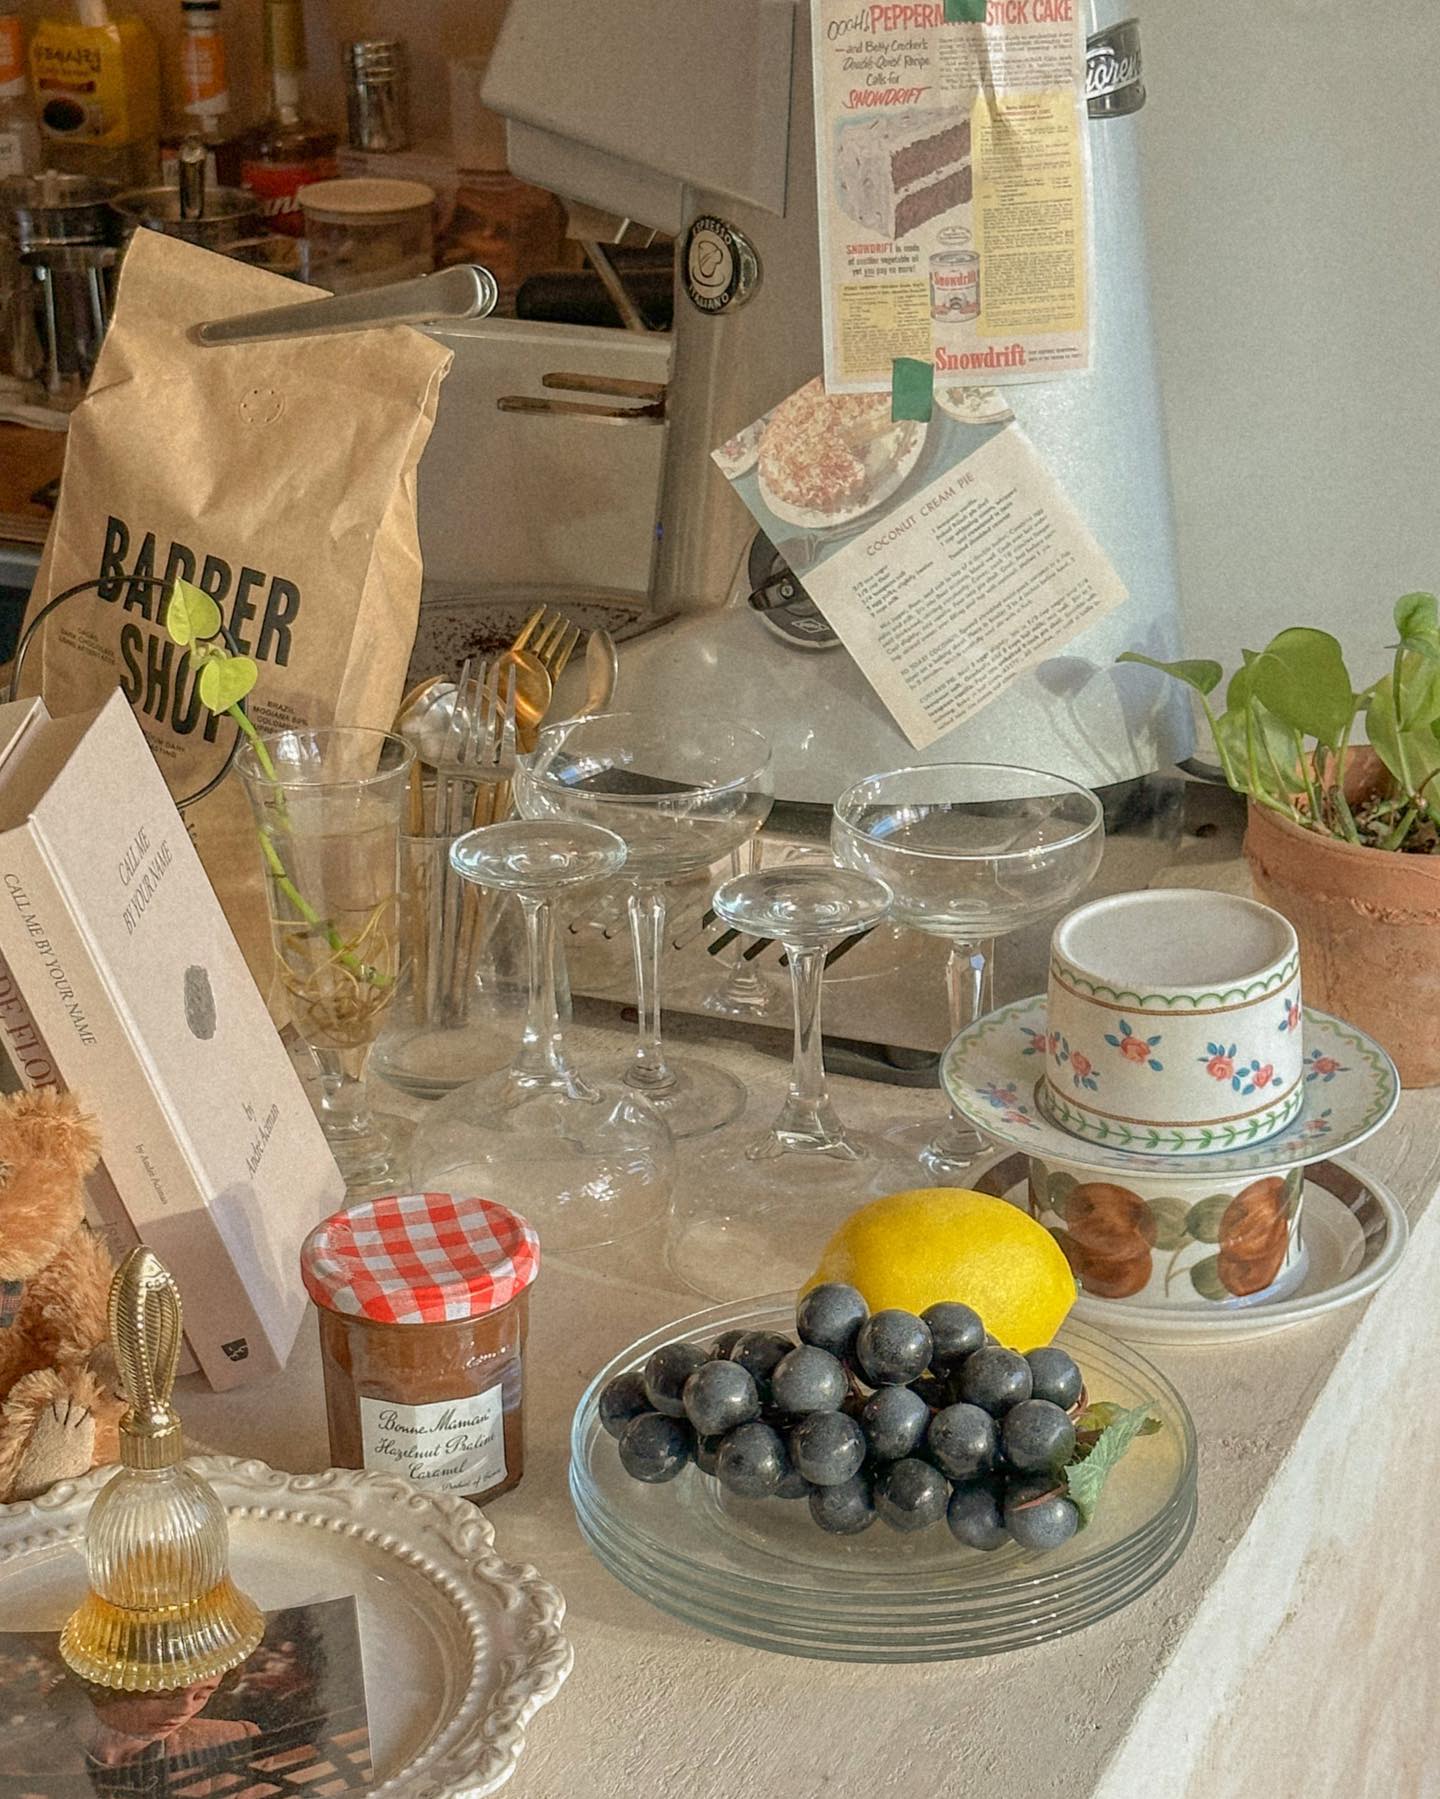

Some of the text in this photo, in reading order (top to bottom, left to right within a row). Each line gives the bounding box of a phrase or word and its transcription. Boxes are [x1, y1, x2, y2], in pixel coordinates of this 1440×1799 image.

[984, 0, 1028, 26] STICK
[1032, 0, 1073, 23] CAKE
[842, 86, 932, 109] SNOWDRIFT
[689, 284, 728, 310] ITALIANO
[935, 343, 1026, 371] Snowdrift
[866, 514, 917, 557] COCONUT
[919, 486, 956, 517] CREAM
[956, 471, 976, 489] PIE
[119, 825, 150, 886] CALL ME
[122, 839, 173, 936] BY YOUR NAME
[4, 873, 97, 1046] CALL ME BY YOUR NAME
[378, 1408, 491, 1434] Bonne Maman
[375, 1438, 443, 1462] Hazelnut
[408, 1458, 468, 1480] Caramel
